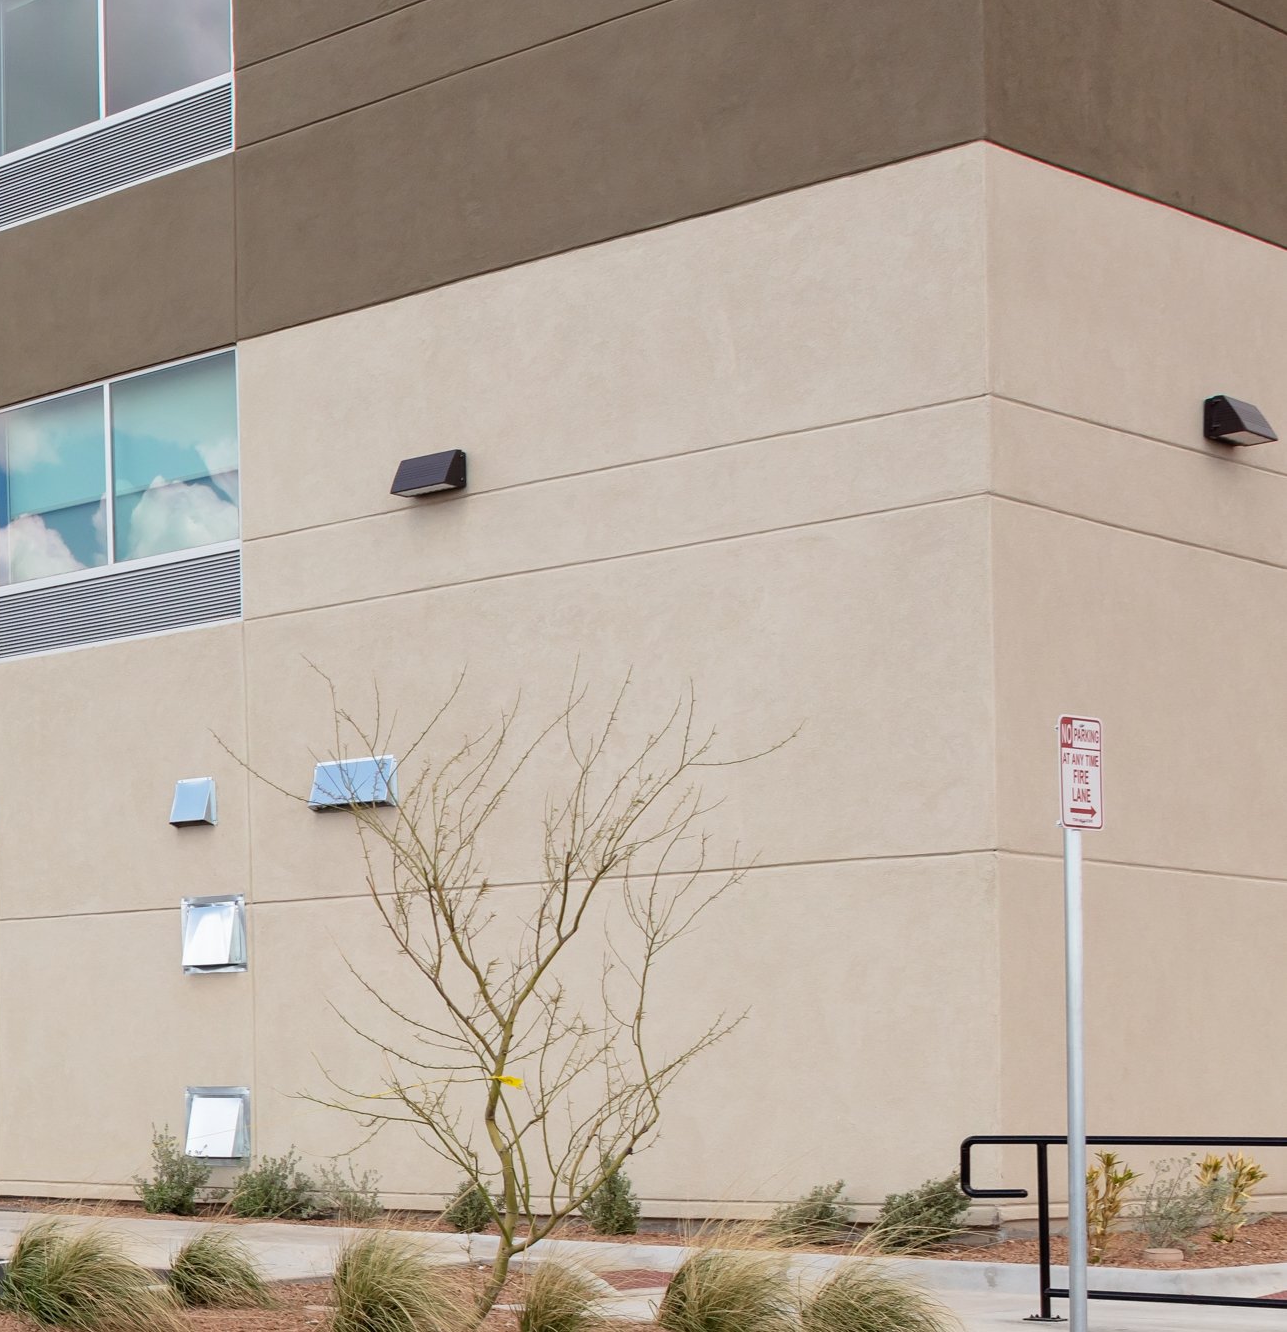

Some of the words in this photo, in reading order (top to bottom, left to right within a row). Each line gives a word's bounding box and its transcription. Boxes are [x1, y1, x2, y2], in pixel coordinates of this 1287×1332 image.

[1061, 723, 1072, 744] NO
[1073, 728, 1099, 744] PARKING
[1062, 752, 1070, 764] AT
[1072, 753, 1084, 766] ANY
[1085, 754, 1099, 767] TIME
[1073, 769, 1089, 785] FIRE
[1072, 787, 1091, 803] LANE
